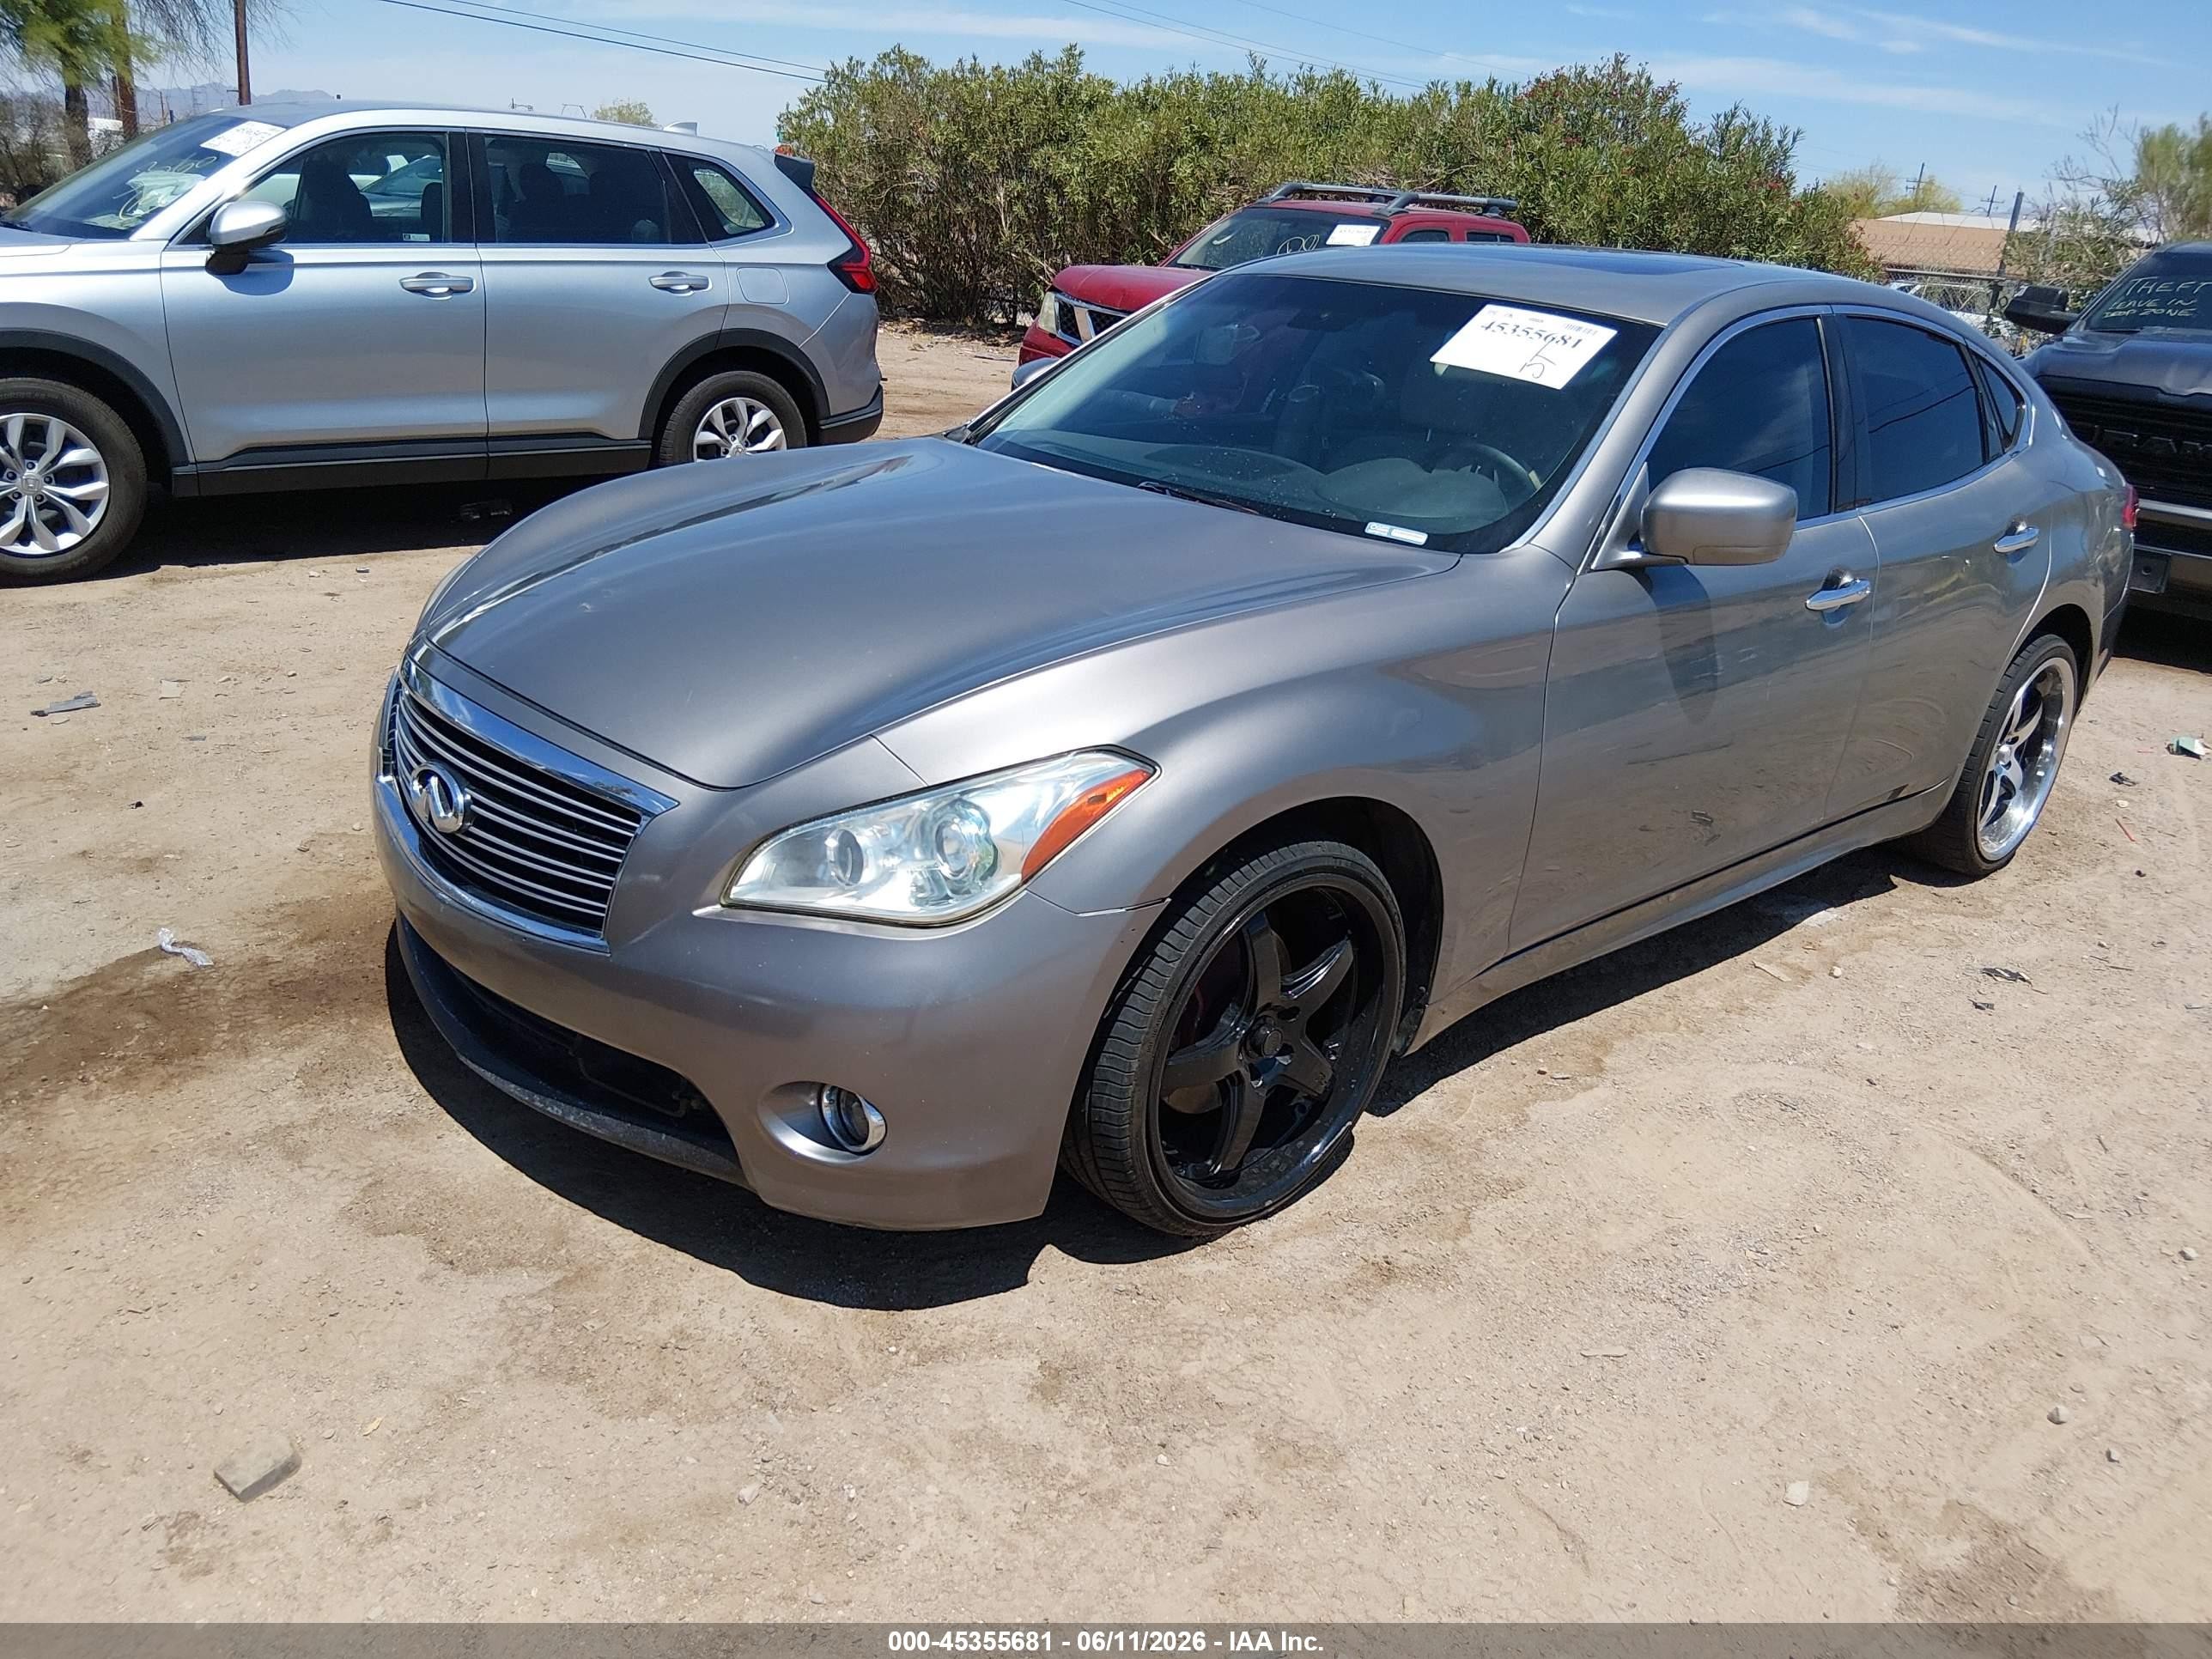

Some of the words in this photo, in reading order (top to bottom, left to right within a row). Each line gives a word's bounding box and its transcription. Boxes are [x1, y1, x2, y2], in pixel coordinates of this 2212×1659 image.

[2125, 276, 2212, 296] THEFT
[2138, 307, 2197, 317] ZONE
[1480, 320, 1583, 349] 45355681
